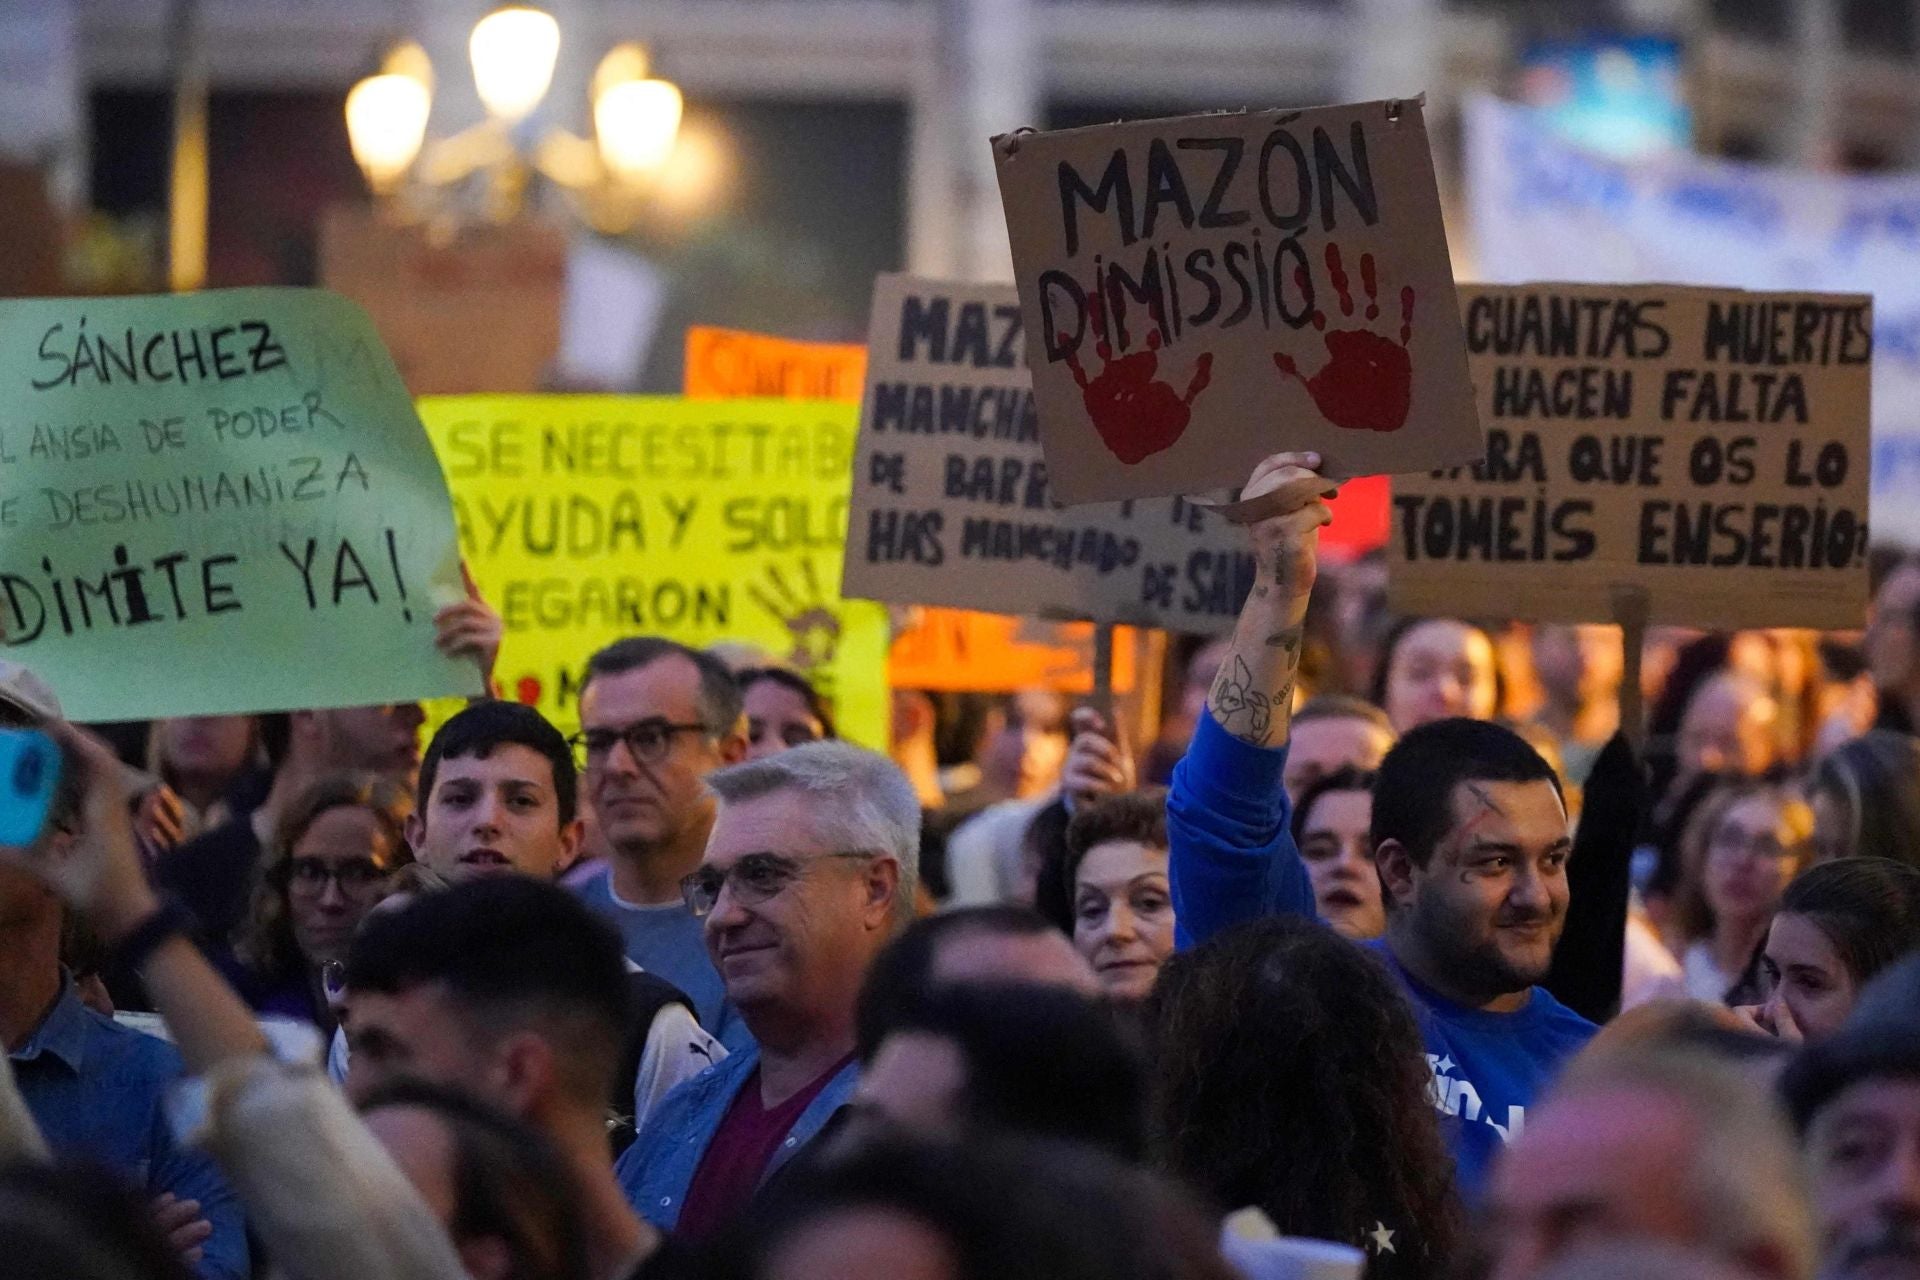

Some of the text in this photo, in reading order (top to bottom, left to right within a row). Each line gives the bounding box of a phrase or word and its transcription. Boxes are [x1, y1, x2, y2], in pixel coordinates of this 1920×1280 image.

[1057, 112, 1379, 258] MAZÓN
[31, 316, 288, 391] SÁNCHEZ
[898, 294, 1028, 368] MAZ
[1466, 295, 1671, 359] CUANTAS
[1705, 301, 1872, 366] MUERTES
[139, 417, 186, 454] DE
[208, 390, 346, 443] PODER
[872, 381, 1040, 443] MANCHA
[1492, 366, 1808, 424] HACEN FALTA
[448, 419, 848, 482] SE NECESITAB
[944, 453, 1047, 509] BARR
[1431, 428, 1547, 483] RA
[1568, 434, 1665, 487] QUE
[1689, 435, 1758, 488] OS
[1784, 440, 1848, 490] LO
[661, 497, 697, 550] Y
[865, 508, 946, 567] HAS
[279, 528, 412, 624] YA!
[502, 578, 733, 632] EGARON
